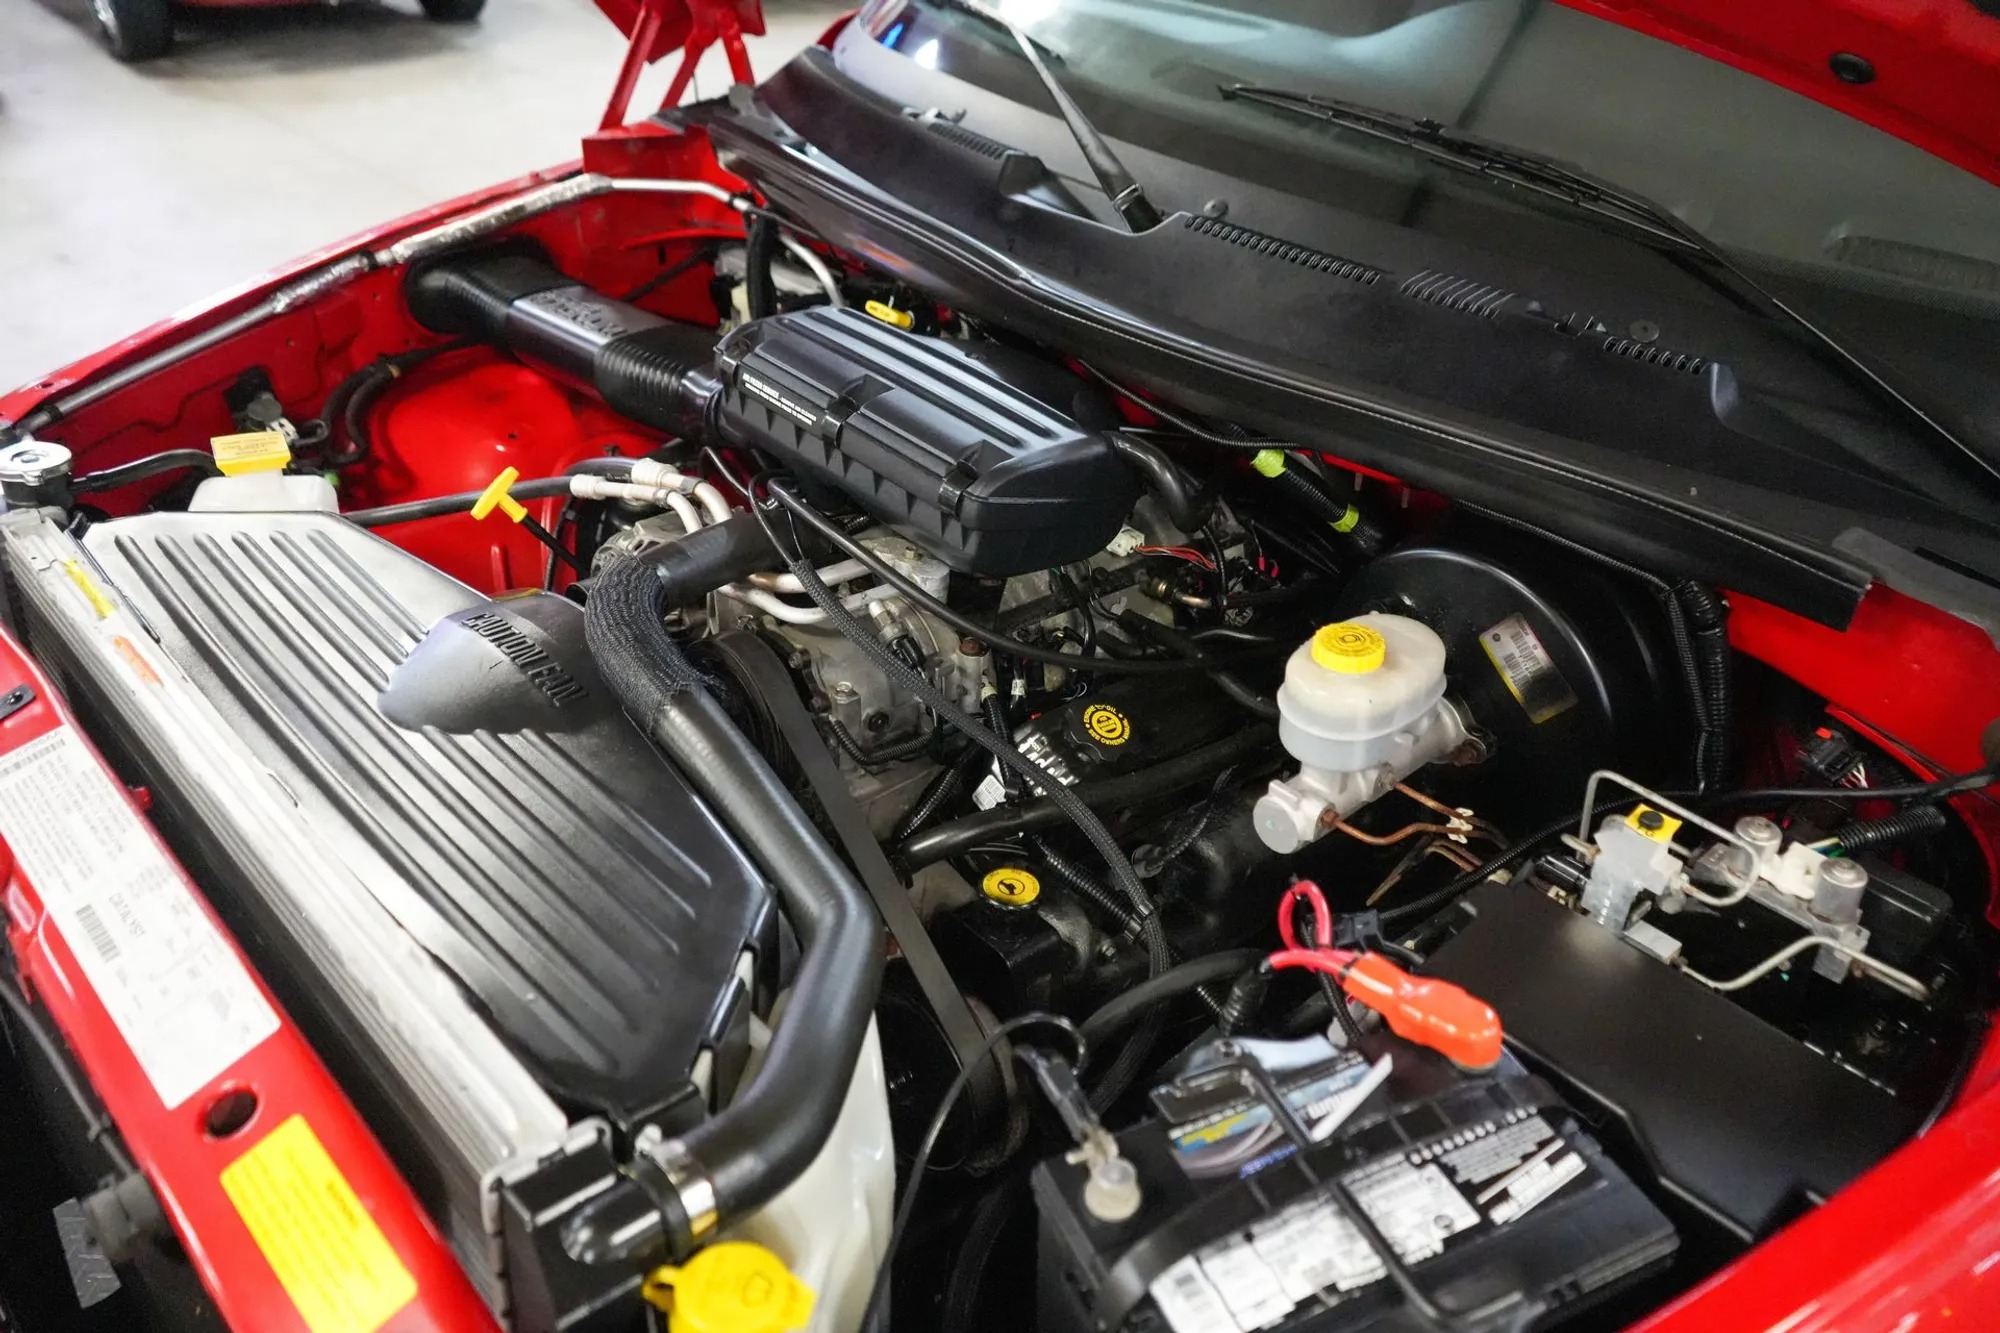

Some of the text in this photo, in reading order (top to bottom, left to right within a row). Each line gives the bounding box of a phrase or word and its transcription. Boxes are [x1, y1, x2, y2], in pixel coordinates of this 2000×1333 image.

[460, 611, 590, 707] CAUTION FAN
[1106, 705, 1117, 715] OIL
[108, 892, 146, 938] CATALYST
